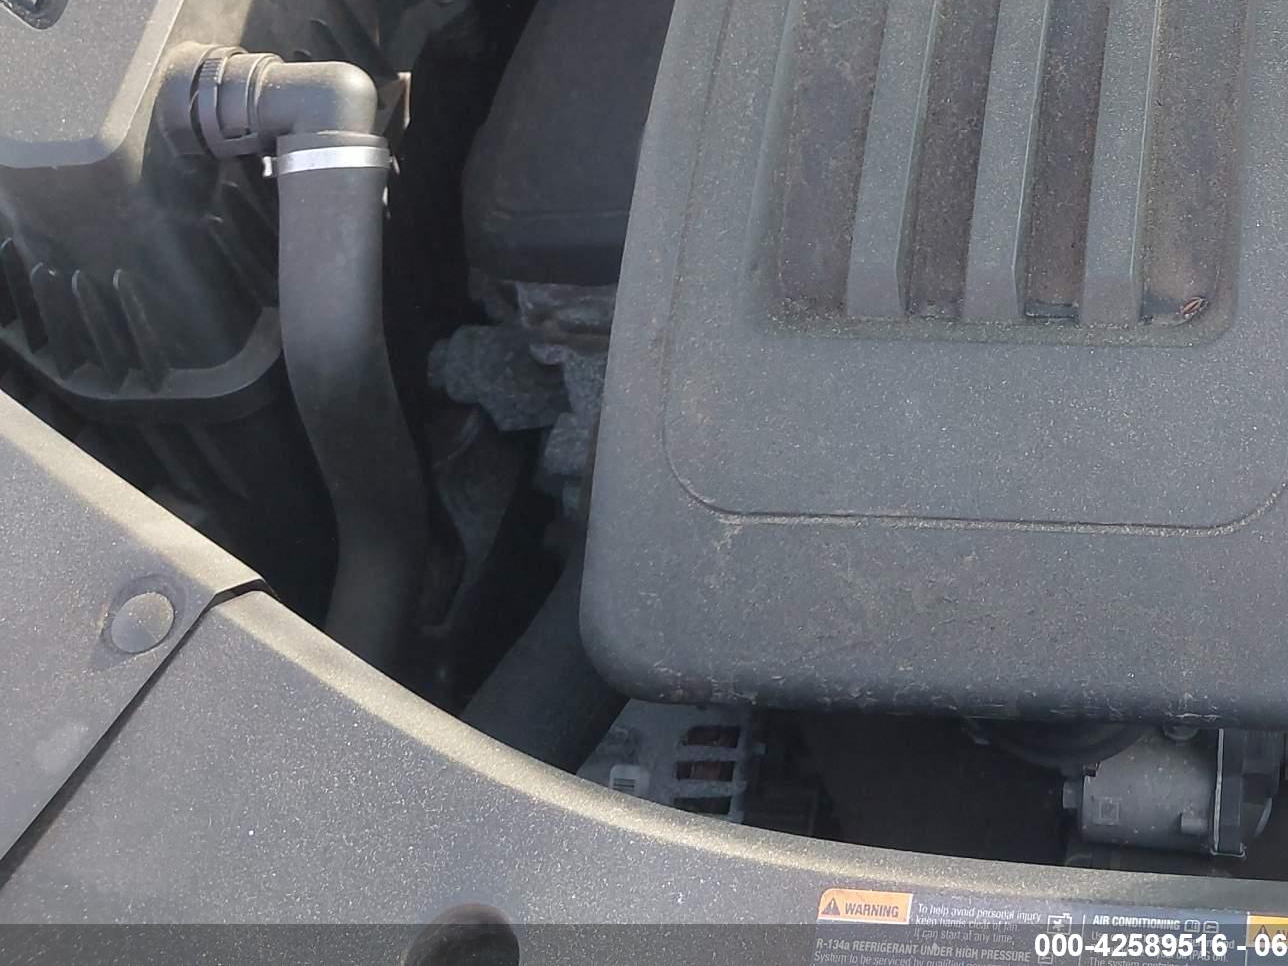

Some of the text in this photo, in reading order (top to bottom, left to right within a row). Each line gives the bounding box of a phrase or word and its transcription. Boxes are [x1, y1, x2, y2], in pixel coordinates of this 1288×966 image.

[845, 901, 899, 918] WARNING
[918, 903, 928, 914] To
[929, 904, 949, 918] help
[951, 907, 976, 917] avoid
[915, 915, 937, 927] keep
[1092, 914, 1181, 931] AIR CONDITIONING
[816, 938, 1031, 962] R-134a REFRIGERANT UNDER HIGH PRESSURE
